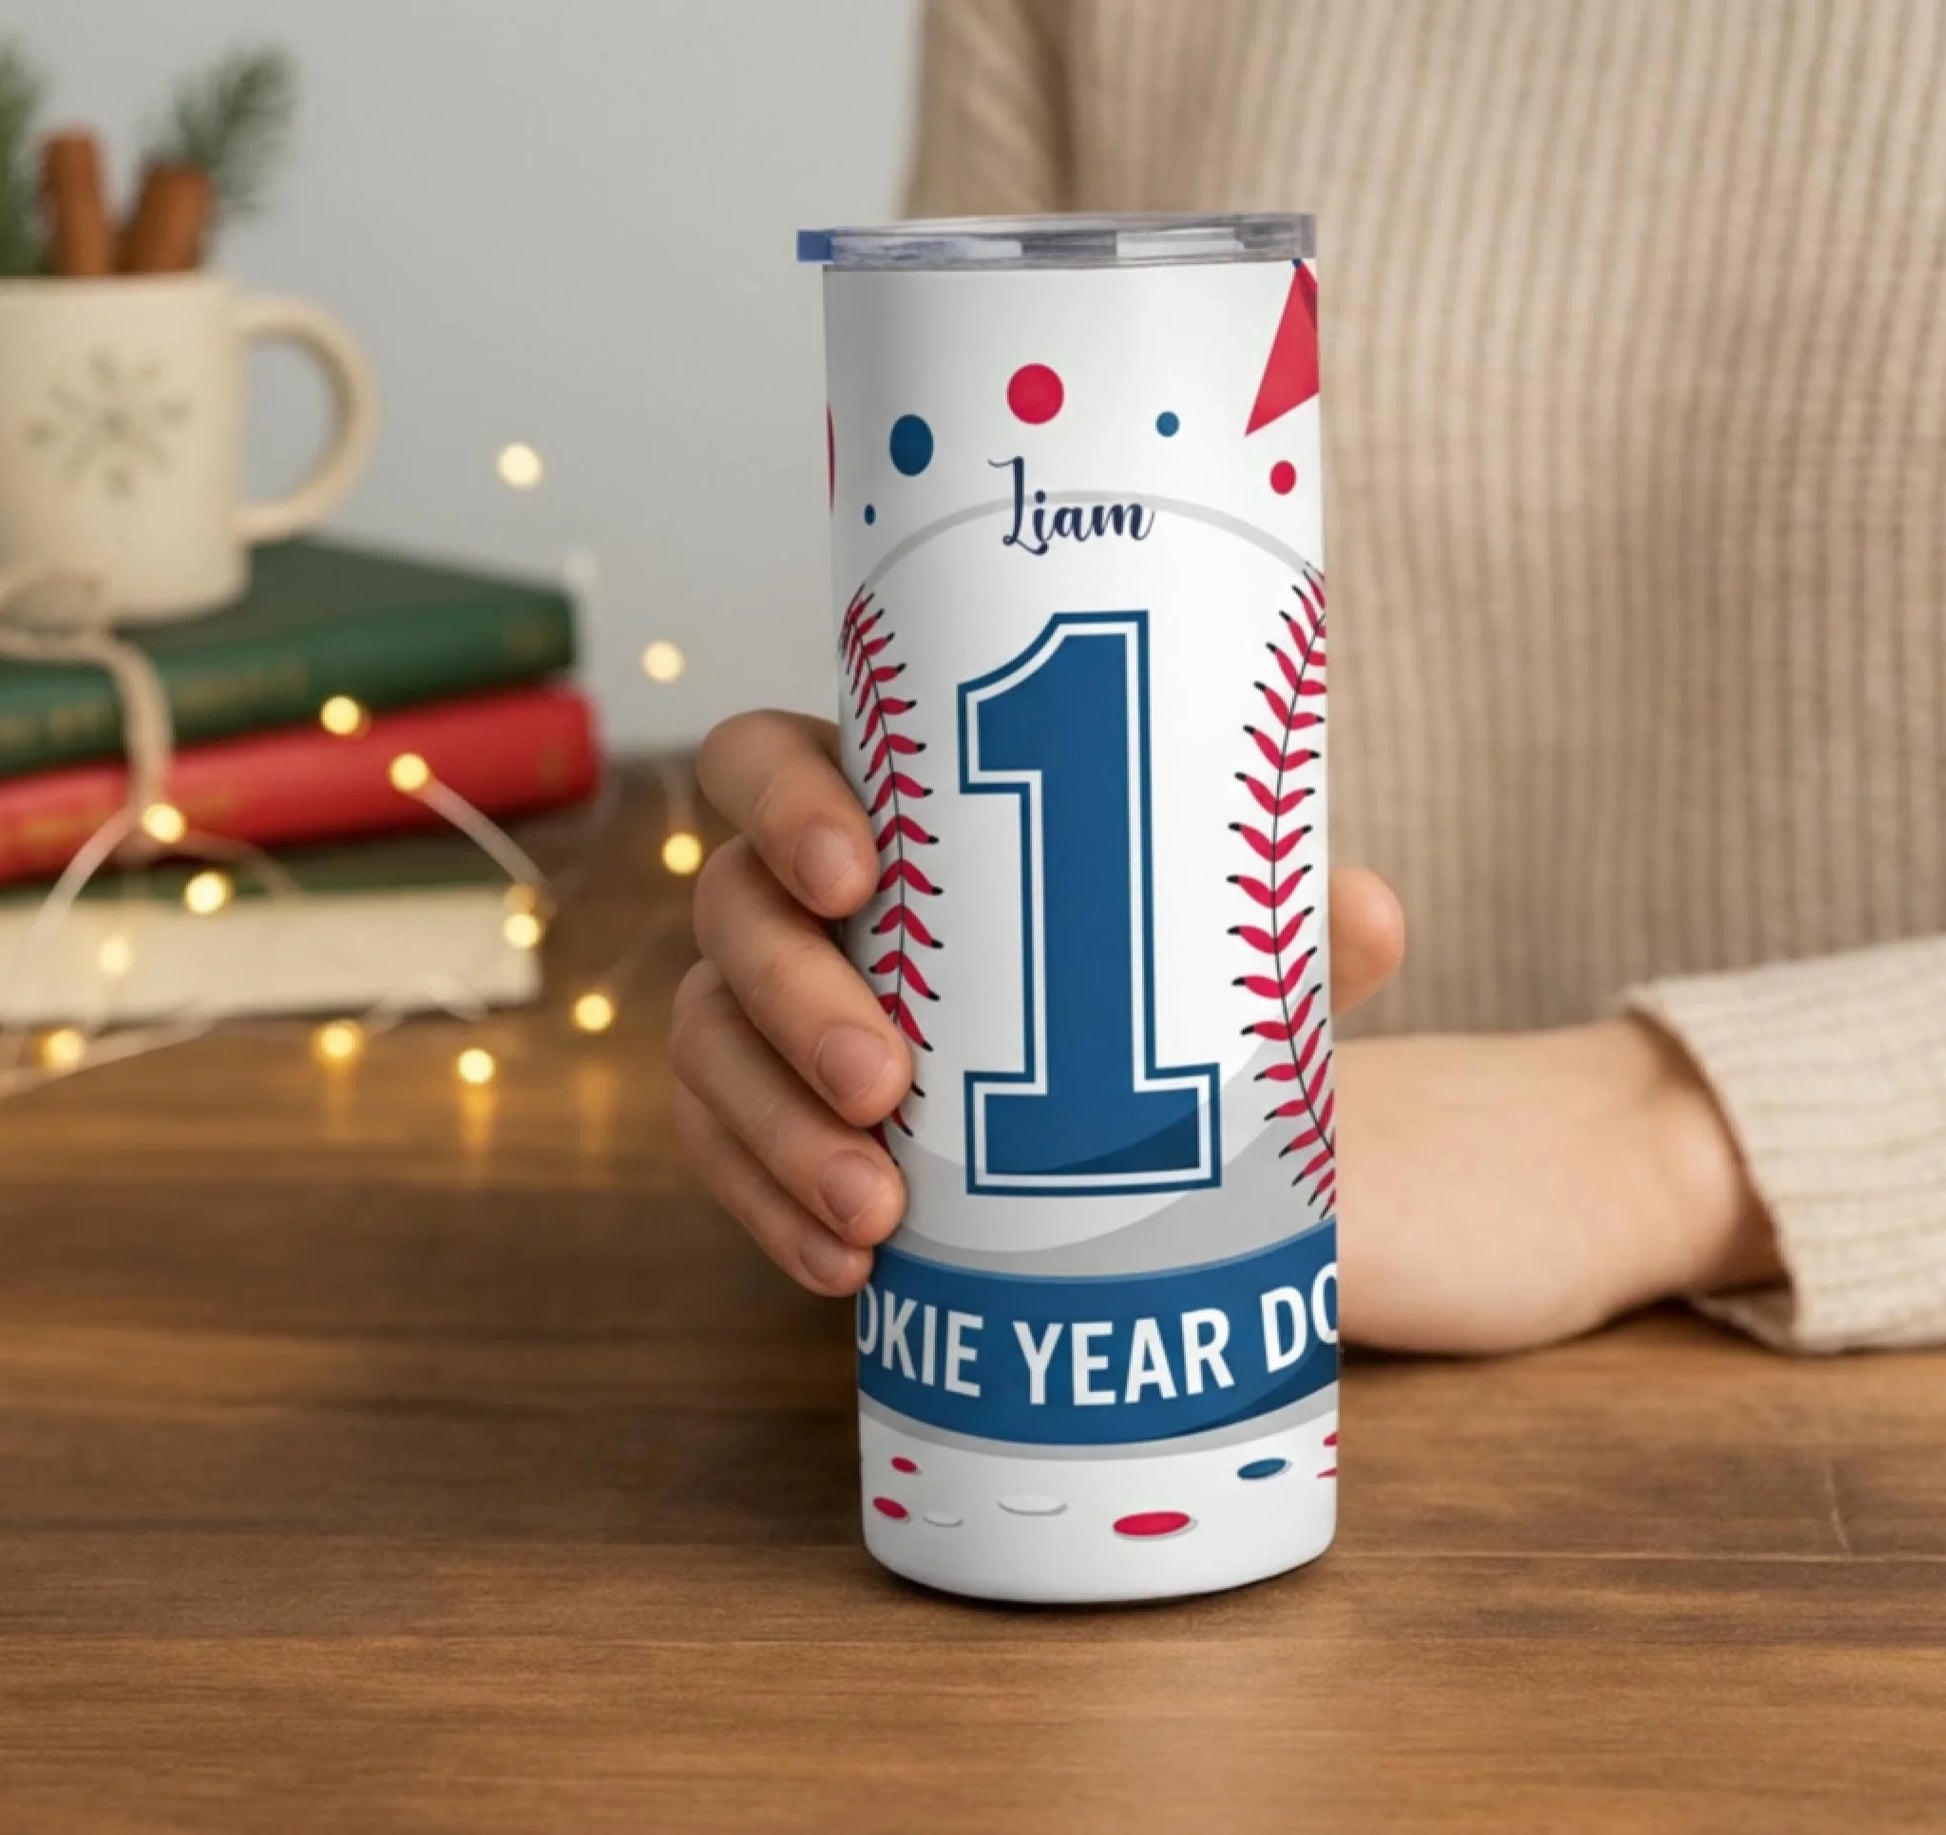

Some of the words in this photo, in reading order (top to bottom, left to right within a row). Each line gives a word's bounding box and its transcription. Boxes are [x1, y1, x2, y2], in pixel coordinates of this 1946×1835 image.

[988, 456, 1155, 555] Liam
[957, 610, 1222, 1197] 1
[1013, 1308, 1235, 1406] YEAR
